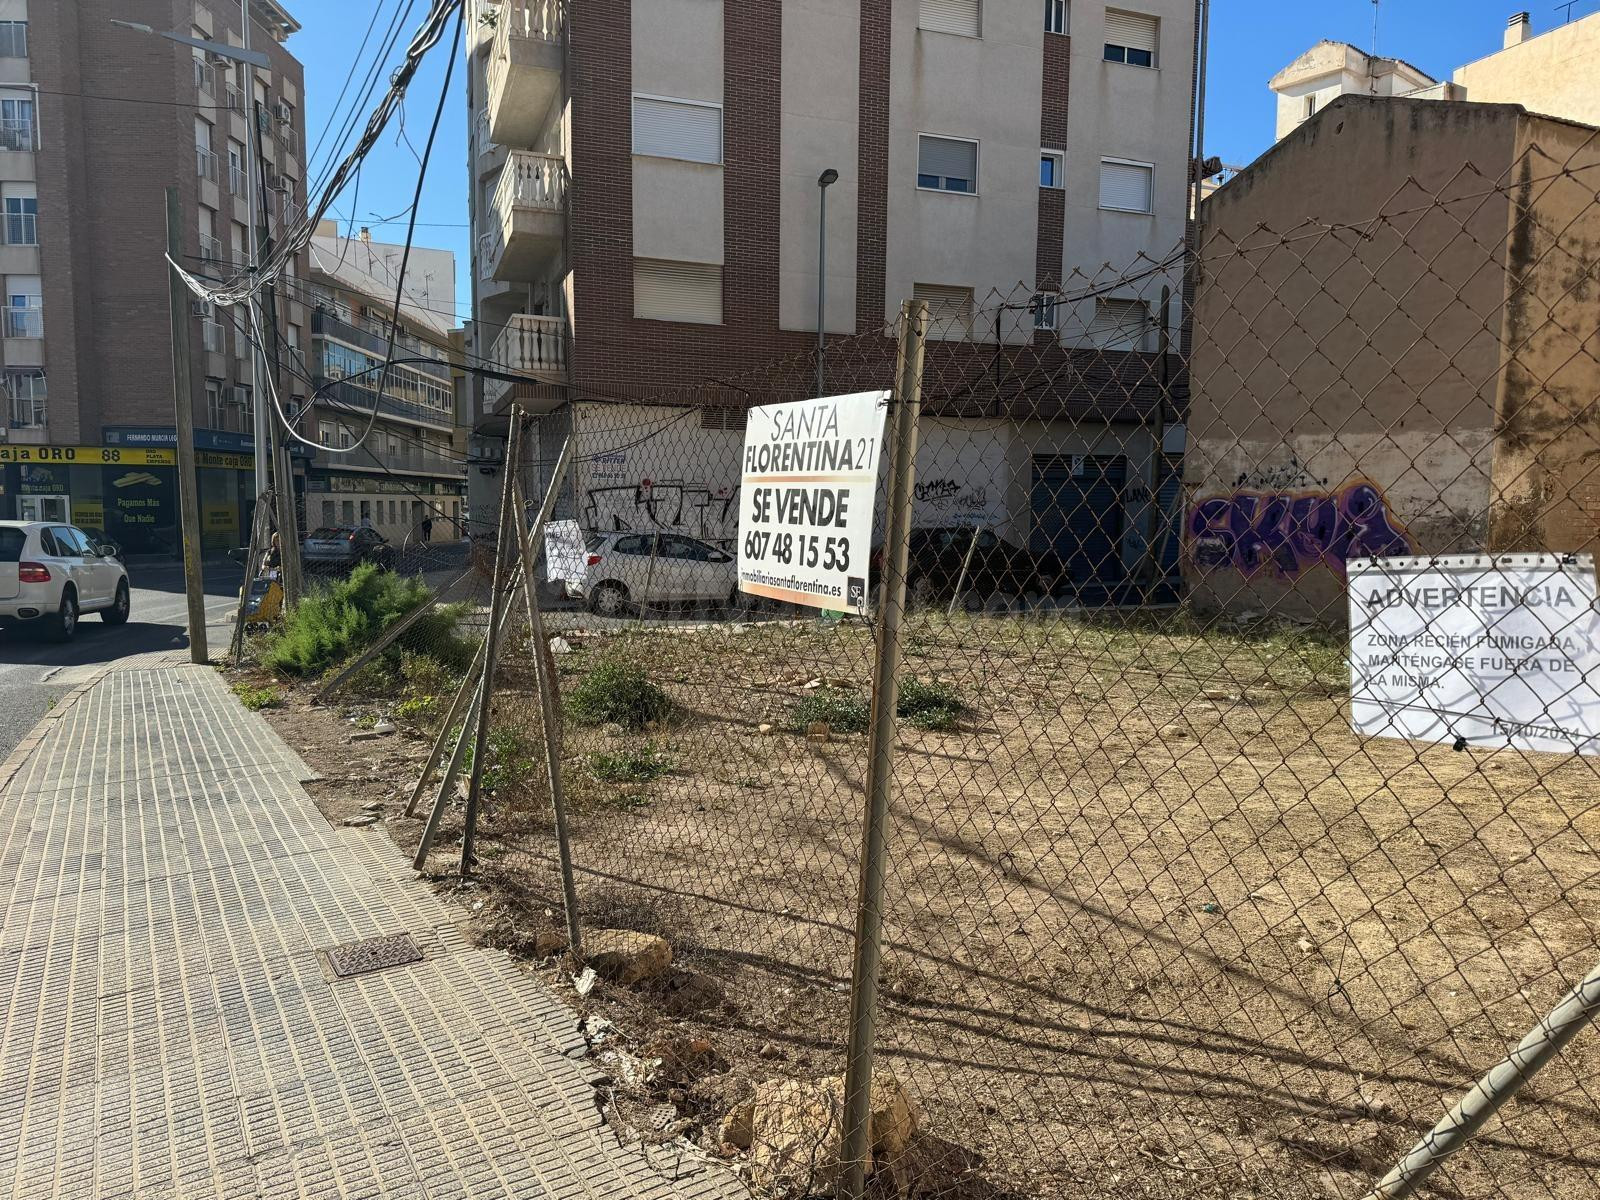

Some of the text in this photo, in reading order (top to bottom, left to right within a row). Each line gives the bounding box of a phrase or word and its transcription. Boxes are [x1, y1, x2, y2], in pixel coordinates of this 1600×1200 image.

[771, 403, 839, 441] SANTA
[126, 434, 151, 442] FERNANDO
[38, 447, 76, 460] ORO
[117, 498, 146, 508] Pagamos
[752, 488, 772, 523] SE
[776, 488, 850, 528] VENDE
[124, 514, 155, 523] Que Nadie
[744, 530, 850, 572] 607 48 15 53
[1367, 585, 1577, 609] ADVERTENCIA
[1367, 634, 1410, 647] ZONA
[1414, 632, 1471, 648] RECIÉN
[1368, 653, 1576, 673] MANTÉNGASE FUERA DE
[1370, 674, 1445, 689] LA MISMA.
